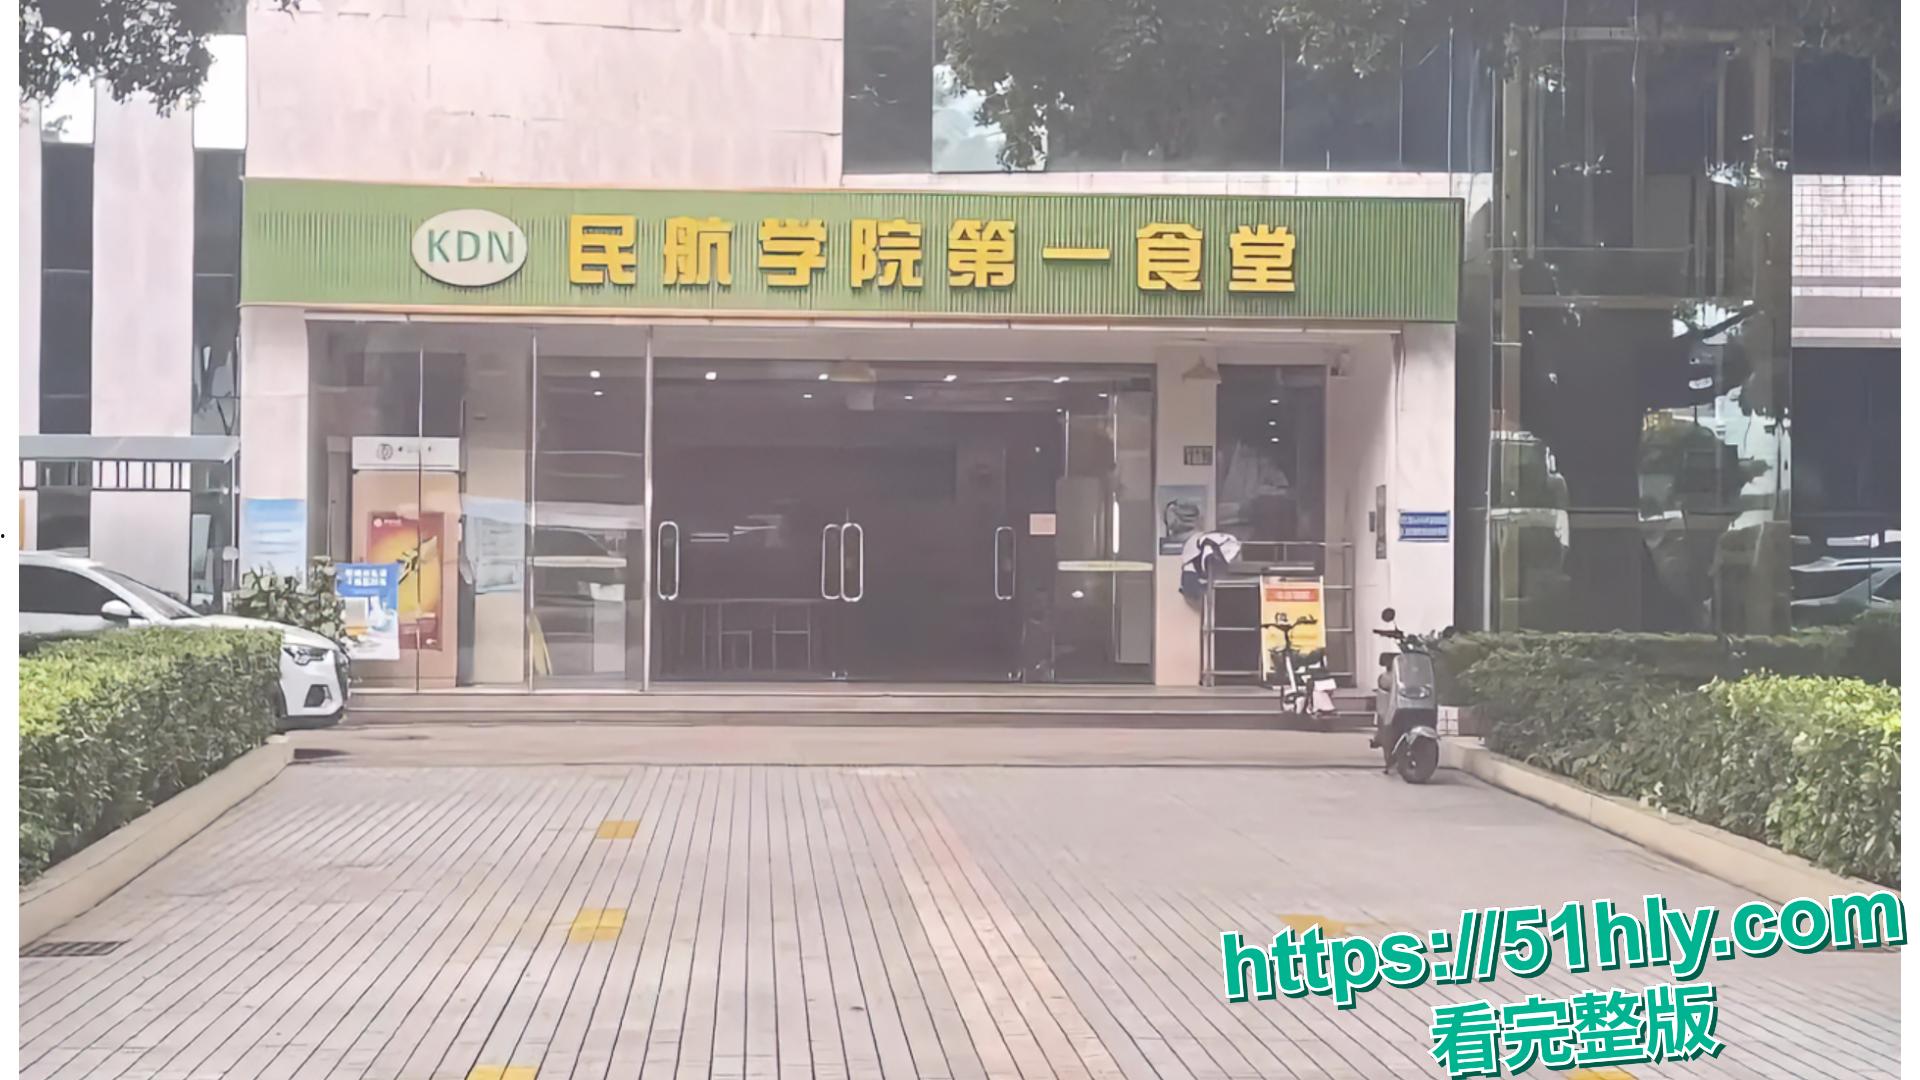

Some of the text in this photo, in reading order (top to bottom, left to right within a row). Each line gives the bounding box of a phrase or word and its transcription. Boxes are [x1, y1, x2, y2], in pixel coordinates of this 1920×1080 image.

[427, 228, 515, 263] KDN
[569, 214, 1297, 292] 民航学院第一食堂
